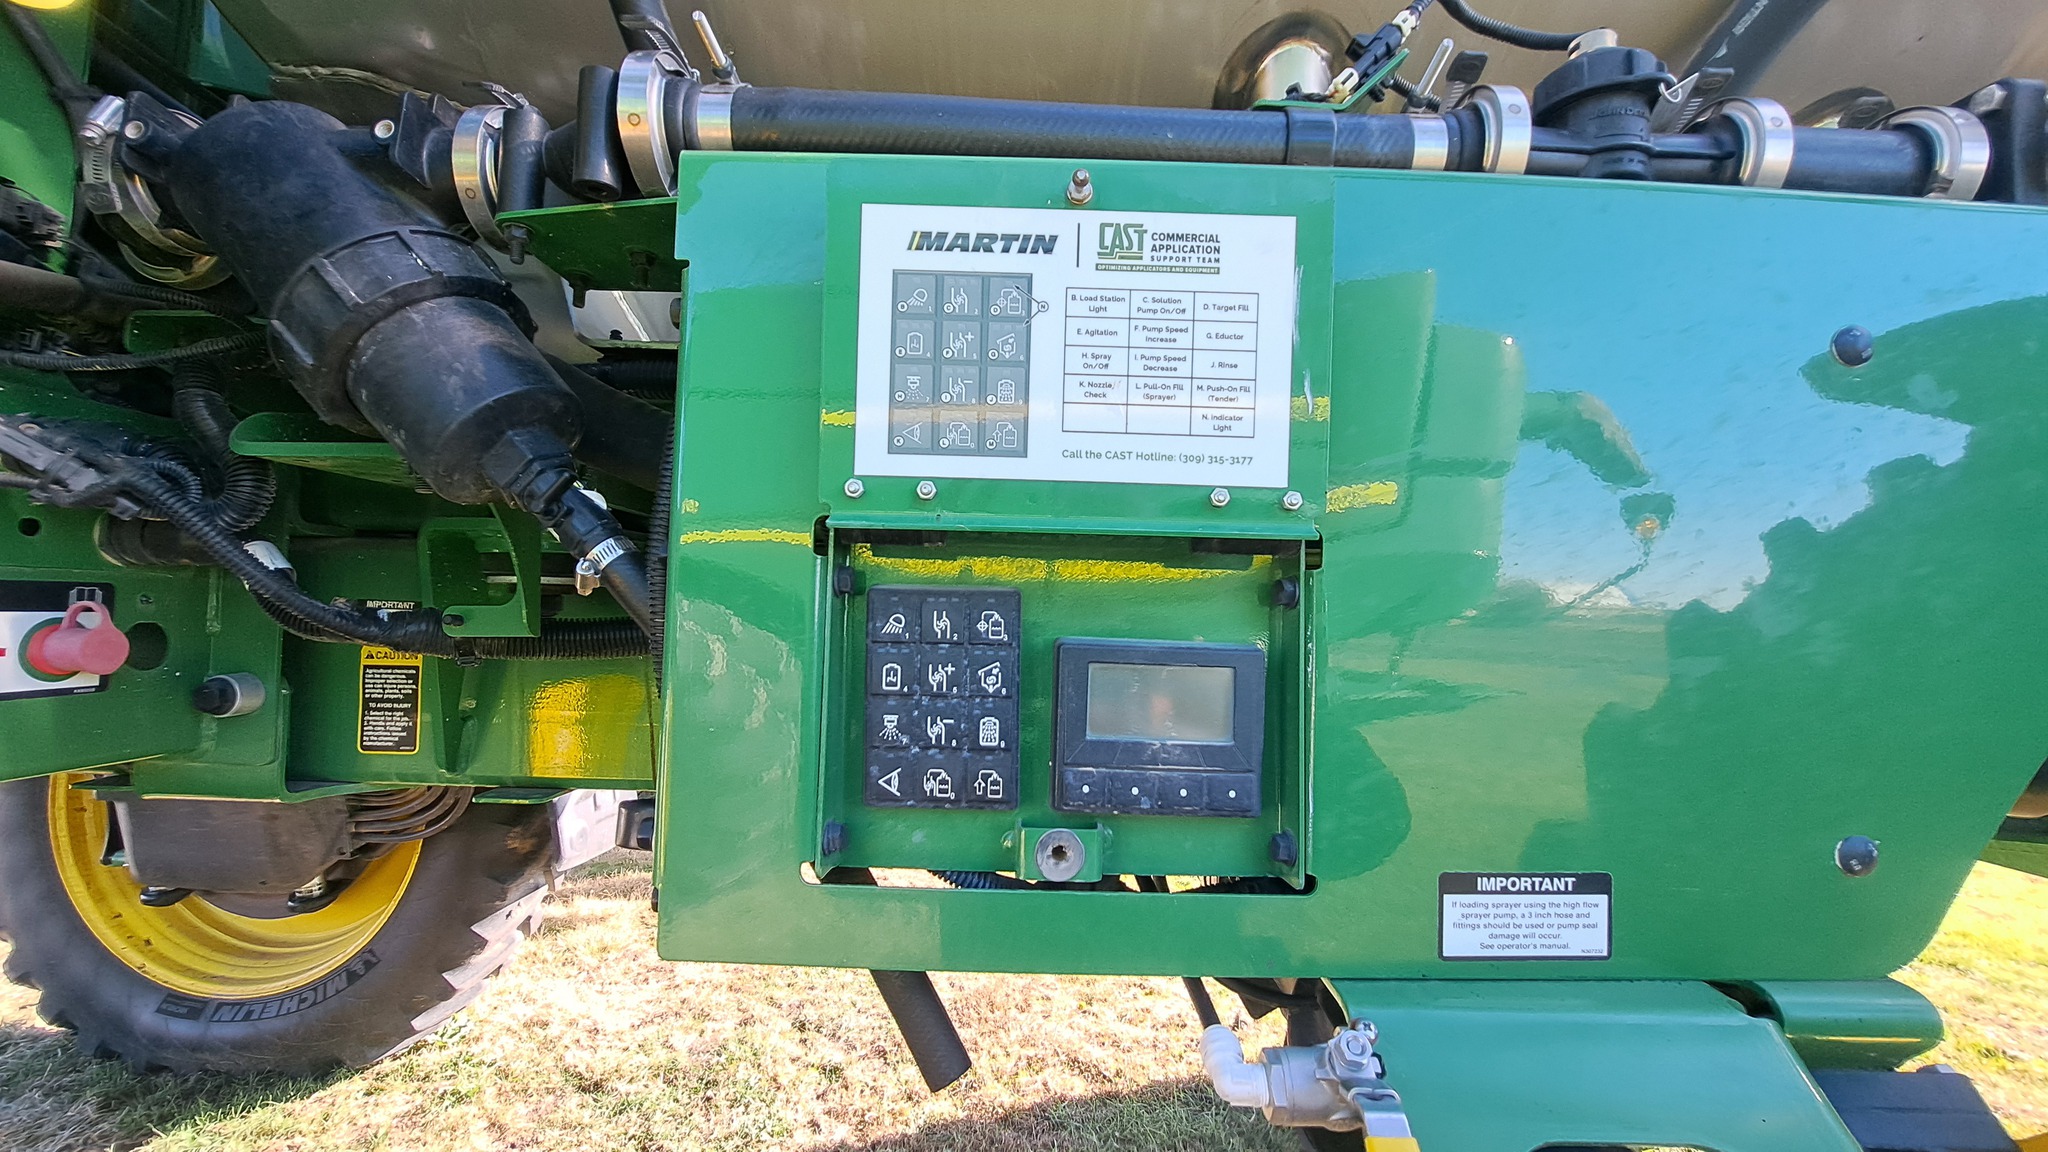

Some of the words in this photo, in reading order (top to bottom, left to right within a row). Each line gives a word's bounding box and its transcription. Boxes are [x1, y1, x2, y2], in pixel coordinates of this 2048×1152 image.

[1098, 222, 1148, 254] CAST
[1151, 232, 1221, 243] COMMERCIAL
[908, 230, 1059, 255] MARTIN
[1150, 244, 1221, 254] APPLICATION
[1150, 255, 1192, 263] SUPPORT
[1137, 307, 1158, 315] Pump
[1212, 304, 1236, 312] Target
[1085, 329, 1118, 337] Agitation
[1142, 325, 1163, 333] Pump
[1165, 326, 1188, 334] Speed
[1140, 354, 1162, 362] Pump
[1143, 393, 1176, 401] (Sprayer)
[1211, 414, 1243, 422] Indicator
[1213, 424, 1232, 432] Light
[1062, 450, 1083, 459] Call
[1085, 450, 1102, 460] the
[1104, 451, 1133, 460] CAST
[1136, 452, 1176, 462] Hotline:
[1179, 453, 1204, 464] (309)
[1208, 455, 1253, 466] 315-3177
[366, 600, 415, 609] IMPORTANT
[376, 651, 418, 660] CAUTION
[1477, 877, 1576, 892] IMPORTANT
[1459, 901, 1489, 910] loading
[1492, 902, 1521, 910] sprayer
[1524, 902, 1546, 910] using
[1563, 901, 1580, 910] high
[1461, 912, 1491, 920] sprayer
[1453, 922, 1481, 930] fittings
[1488, 932, 1520, 940] damage
[1480, 942, 1494, 950] See
[1497, 942, 1537, 950] operator's
[211, 972, 348, 1022] MICHELIN
